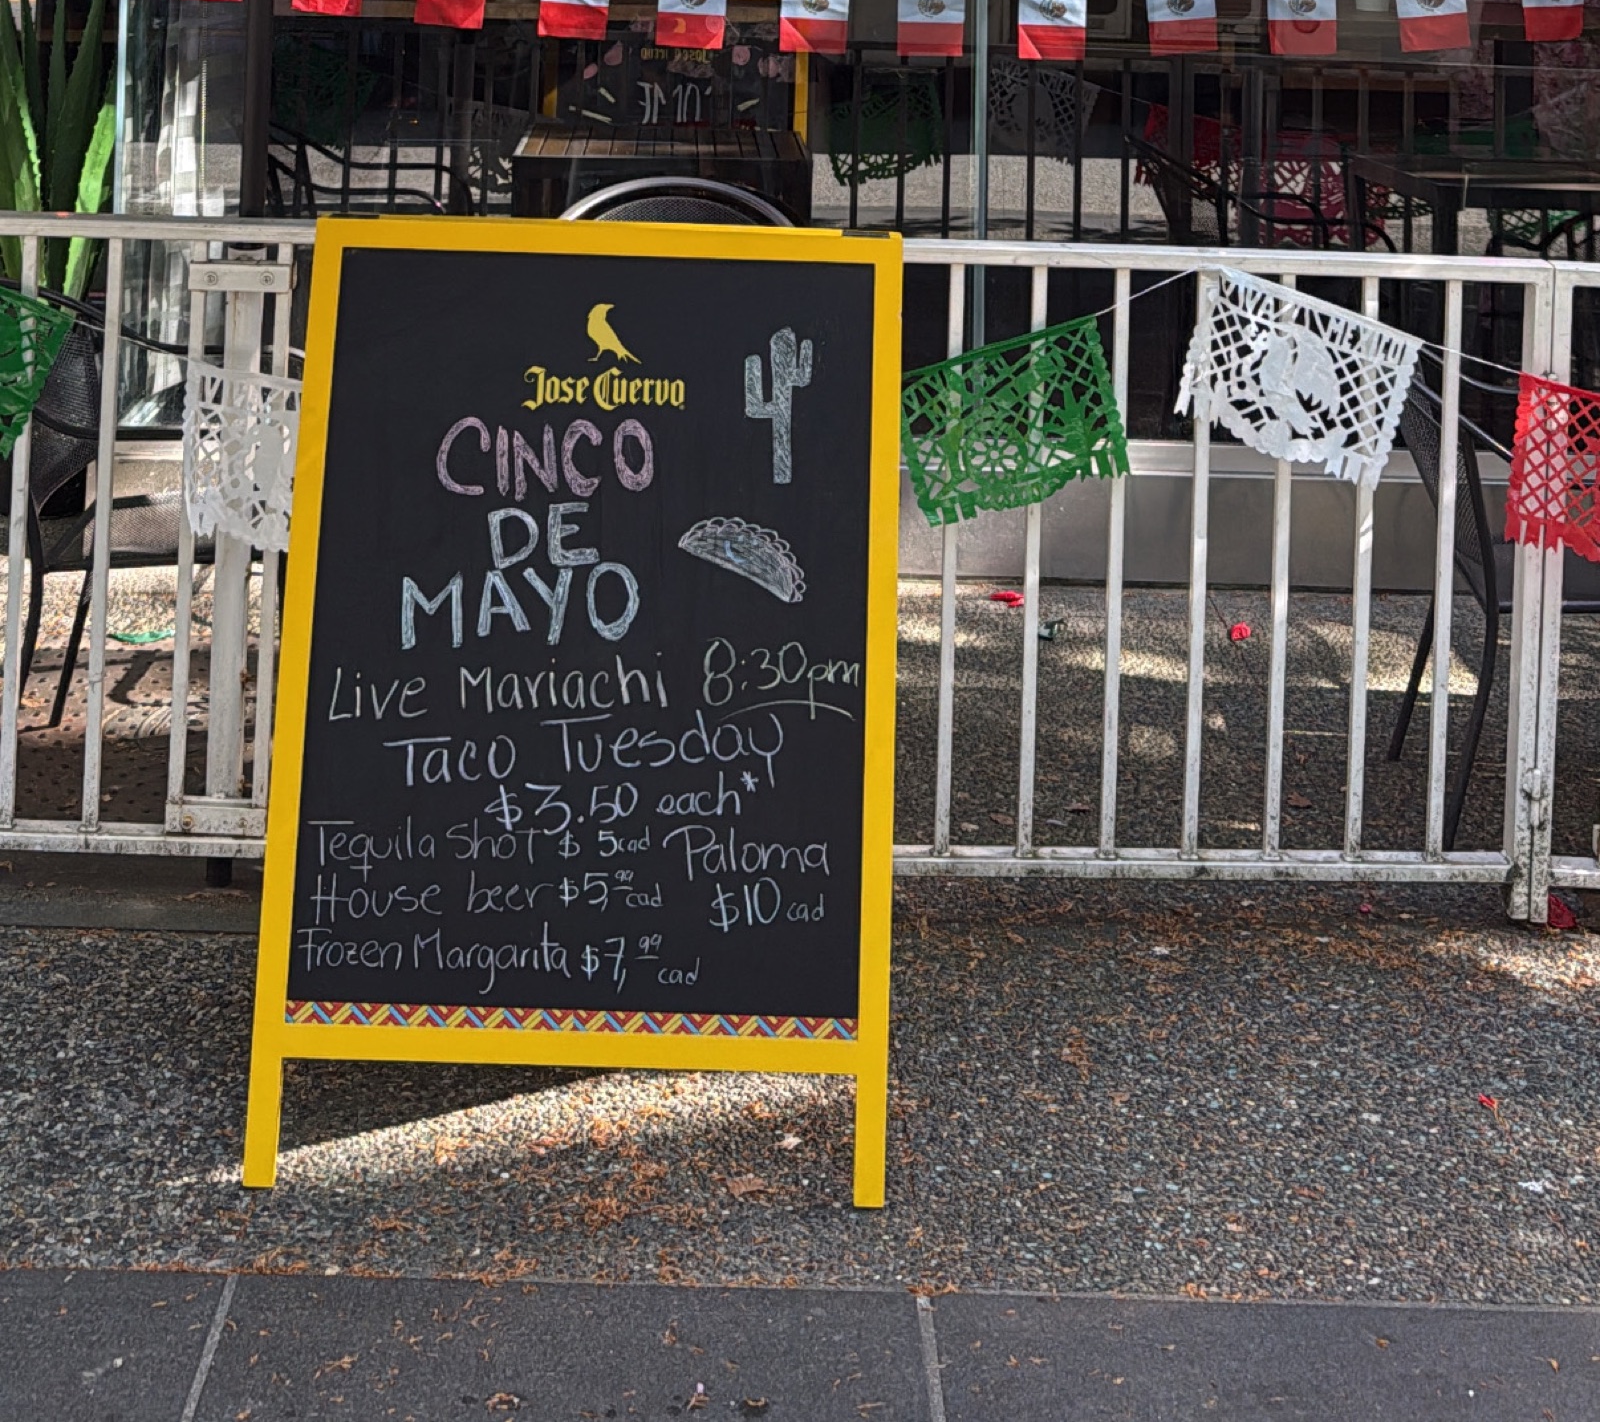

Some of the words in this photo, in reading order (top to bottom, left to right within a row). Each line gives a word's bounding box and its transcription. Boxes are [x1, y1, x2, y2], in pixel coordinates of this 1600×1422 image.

[521, 365, 590, 410] Jose
[593, 366, 686, 411] Cuervo
[436, 416, 654, 502] CINCO
[487, 502, 600, 569] DE
[401, 562, 640, 650] MAYO
[329, 666, 428, 721] Live
[459, 651, 668, 714] Mariachi
[702, 636, 861, 720] 8:30pm
[382, 734, 517, 787] Taco
[540, 709, 784, 789] Tuesday
[484, 782, 639, 836] $3.50
[307, 815, 435, 883] Tequila
[662, 824, 830, 882] Paloma
[309, 872, 443, 926] House
[467, 870, 555, 914] beer
[709, 877, 781, 933] $10
[296, 928, 403, 973] Frozen
[413, 921, 572, 995] Margarita
